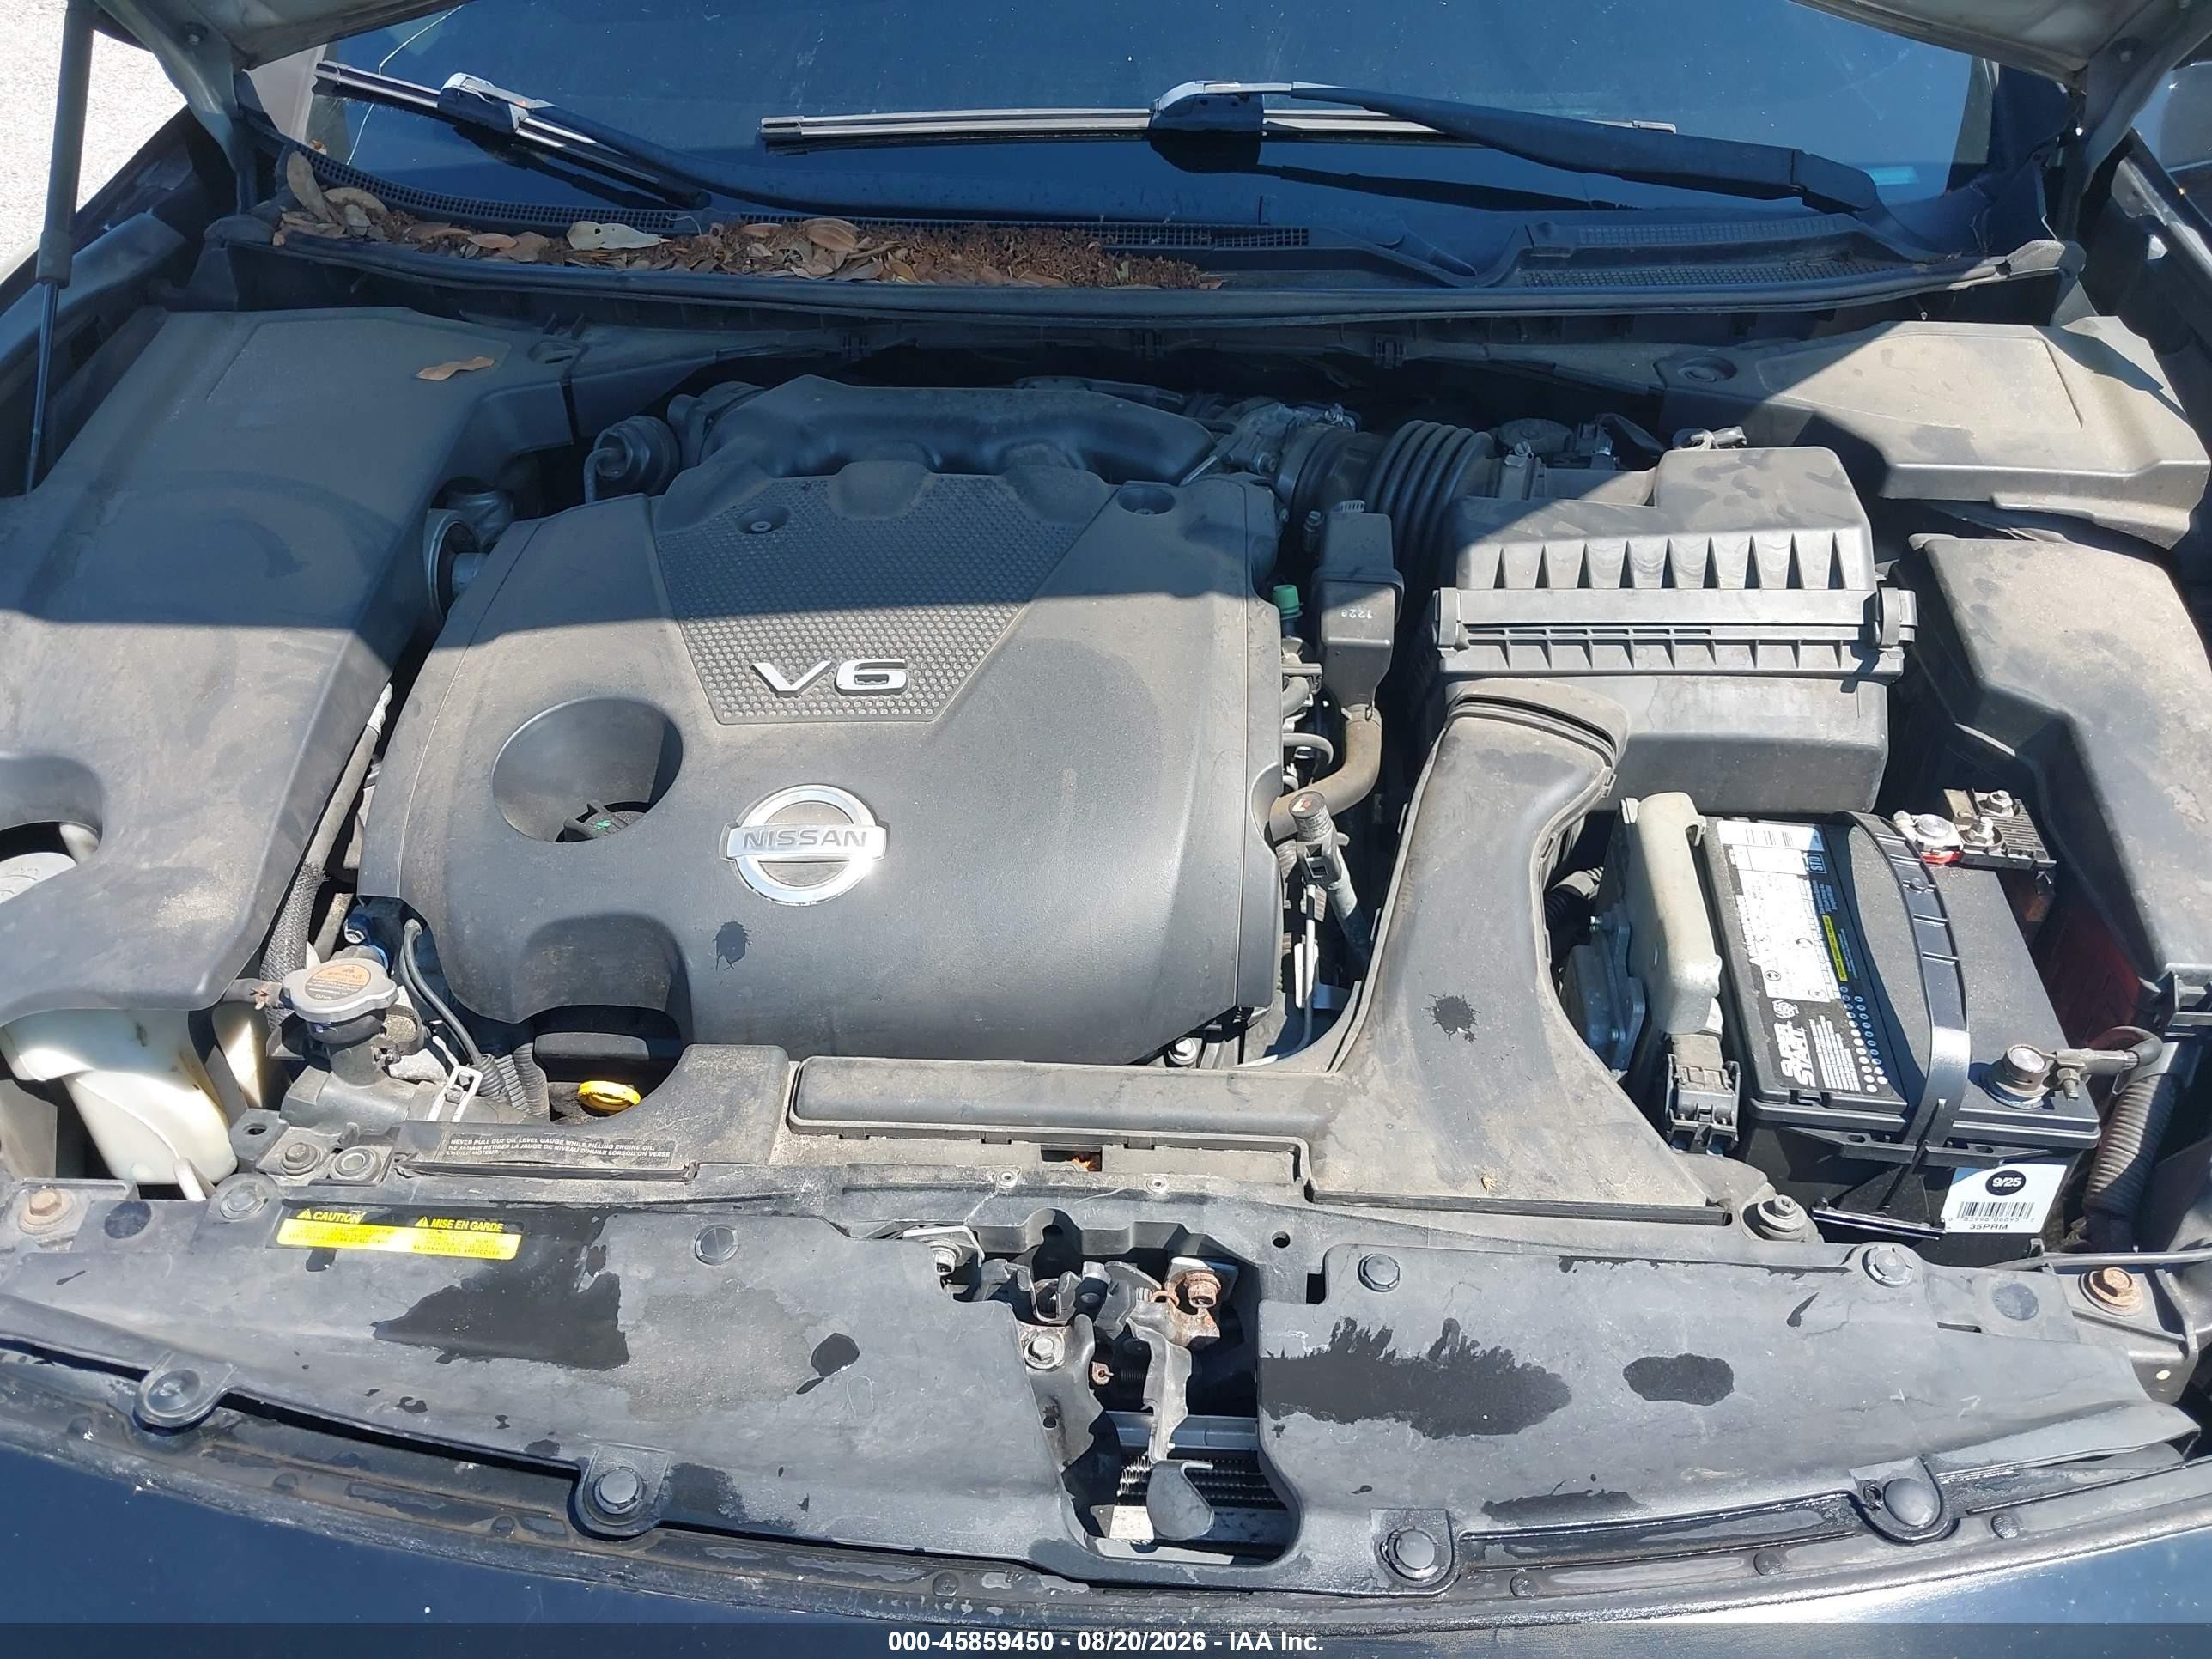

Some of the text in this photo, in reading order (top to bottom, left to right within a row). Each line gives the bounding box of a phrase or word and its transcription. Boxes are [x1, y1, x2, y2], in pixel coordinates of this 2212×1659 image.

[752, 659, 909, 696] V6
[743, 830, 866, 849] NISSAN
[1791, 1026, 1817, 1088] START
[588, 1141, 614, 1150] FILLING
[1992, 1176, 2022, 1188] 9/25
[313, 1211, 367, 1224] CAUTION
[430, 1218, 504, 1232] MISE EN GARDE
